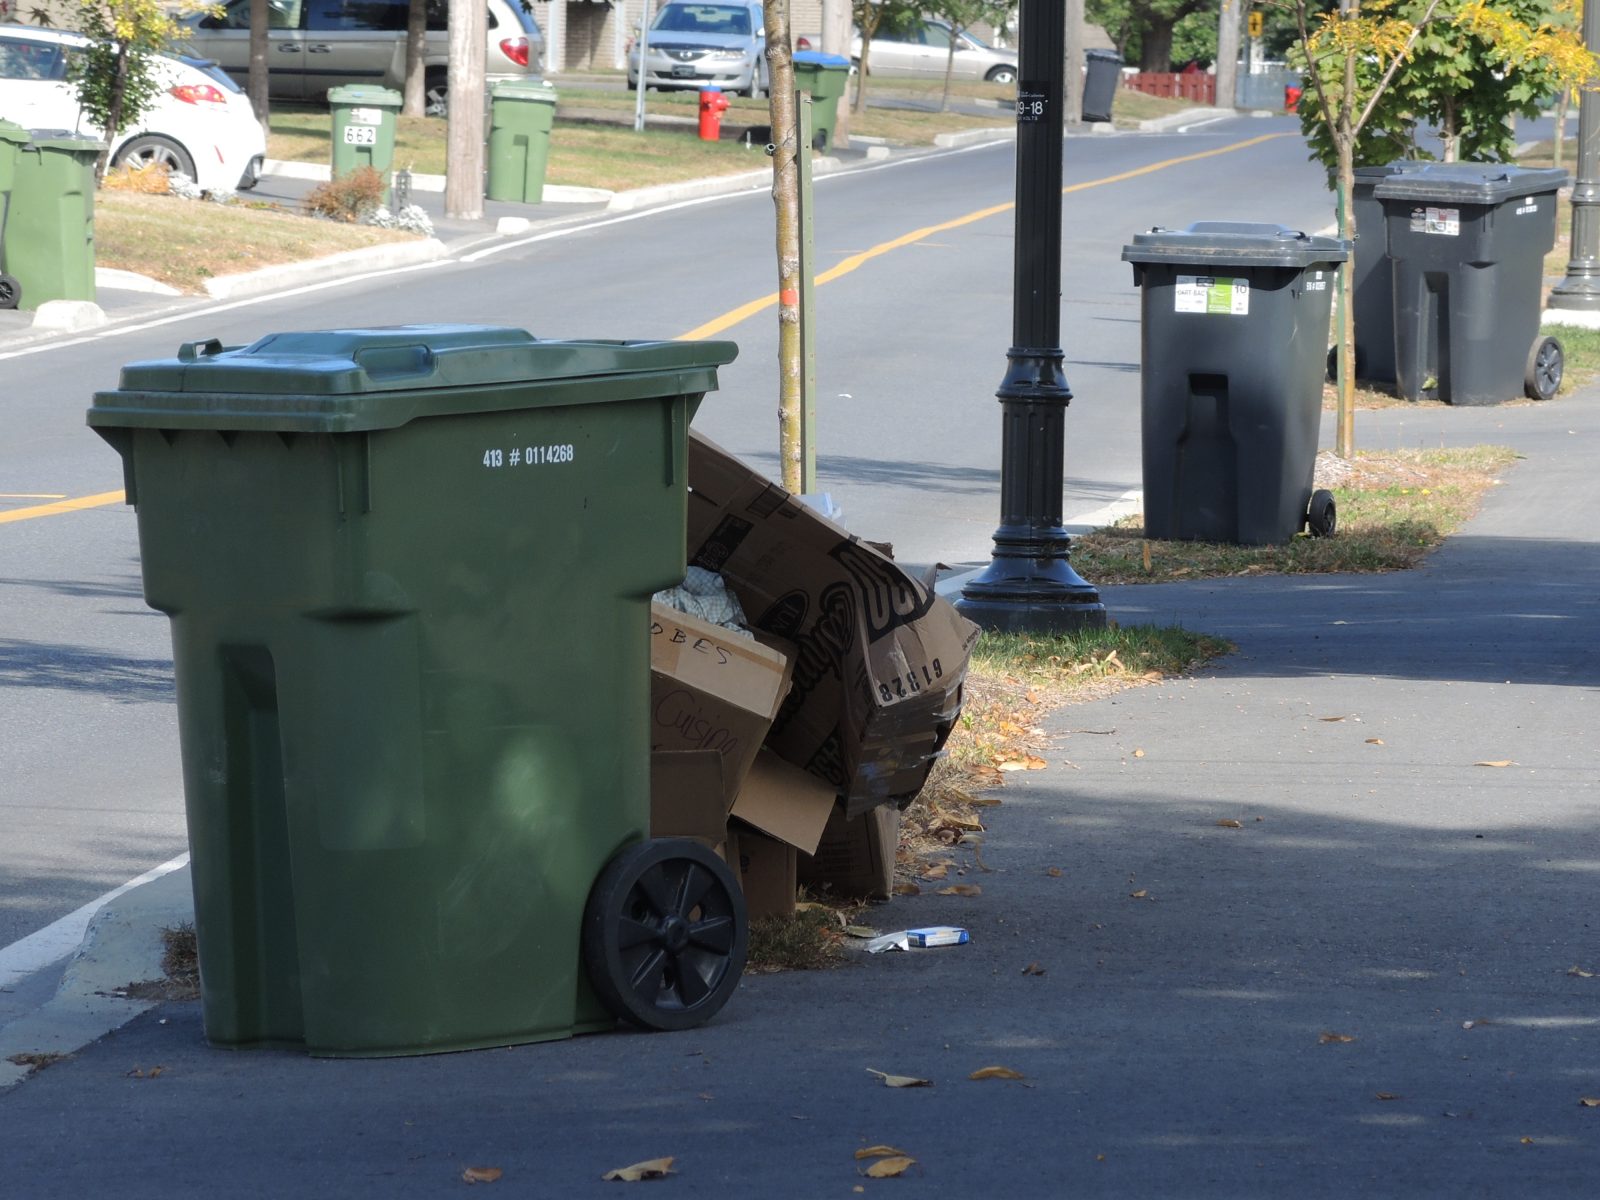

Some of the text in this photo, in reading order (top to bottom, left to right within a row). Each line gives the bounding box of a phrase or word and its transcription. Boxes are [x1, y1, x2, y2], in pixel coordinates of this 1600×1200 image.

[346, 127, 373, 143] 662
[1234, 284, 1247, 294] 10
[482, 444, 574, 468] 413 # 0114268
[880, 658, 943, 703] 61328
